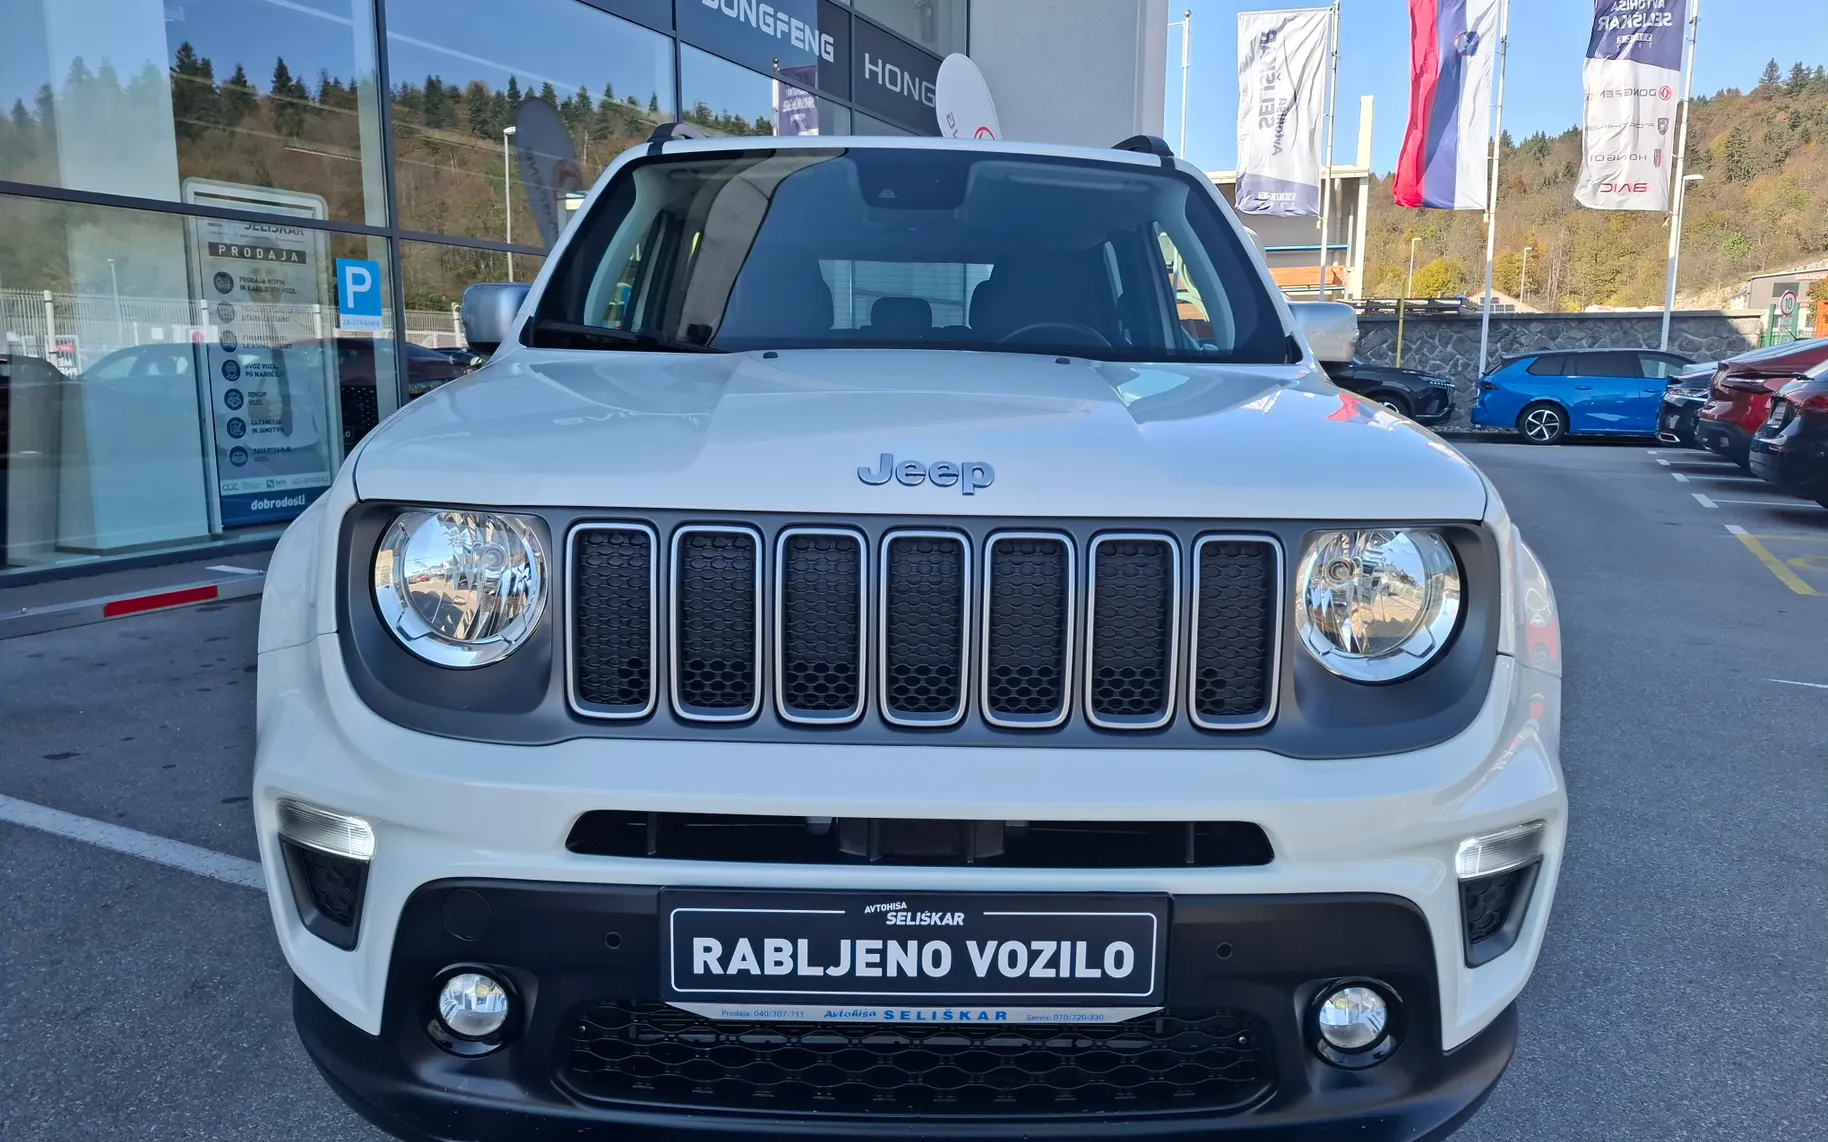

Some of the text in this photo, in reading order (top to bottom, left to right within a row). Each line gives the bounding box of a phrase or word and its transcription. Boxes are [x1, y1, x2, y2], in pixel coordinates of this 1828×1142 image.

[218, 244, 298, 262] PRODAJA
[345, 266, 372, 308] P
[1785, 297, 1793, 309] 10
[857, 453, 994, 496] Jeep
[864, 901, 907, 914] AVTOHIŠA
[886, 911, 965, 926] SELIŠKAR
[692, 937, 1134, 978] RABLJENO VOZILO
[721, 1009, 804, 1018] Prodaja: 040/307-711
[883, 1008, 1007, 1021] SELIŠKAR
[1053, 1013, 1104, 1021] 070/720-330
